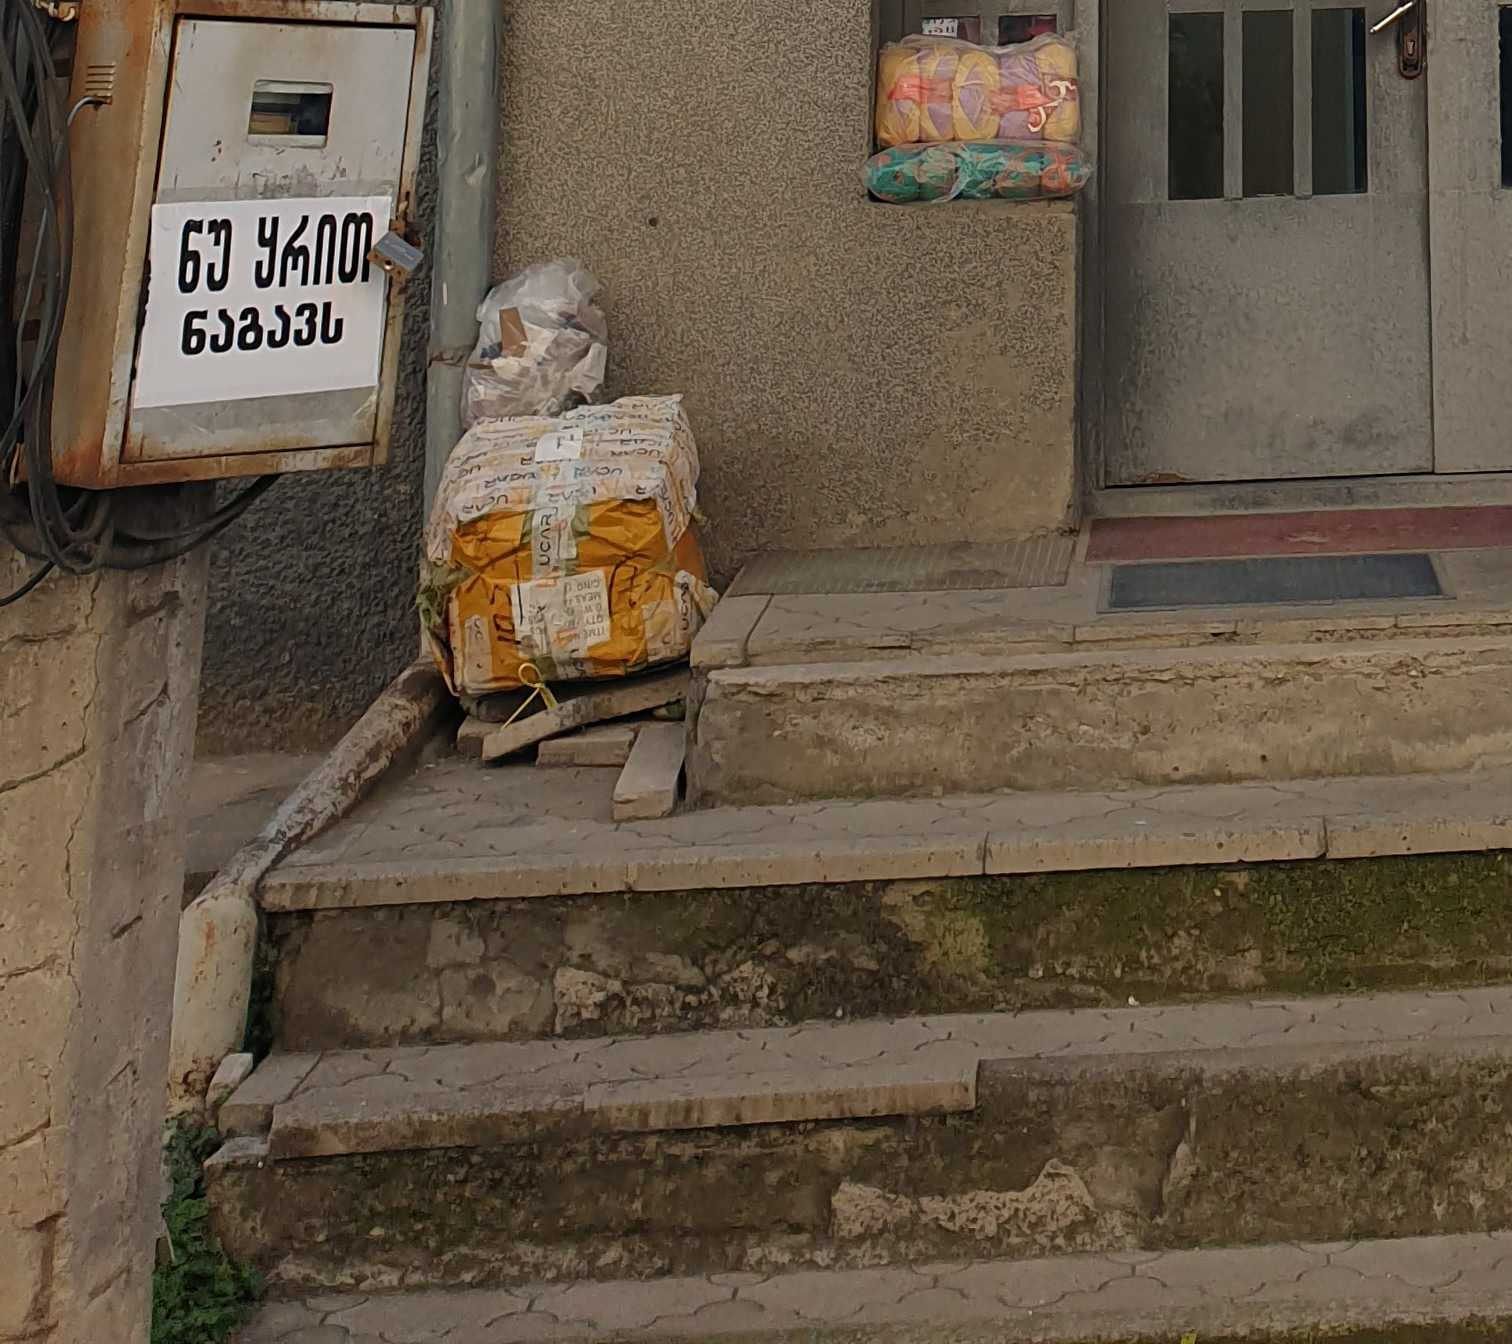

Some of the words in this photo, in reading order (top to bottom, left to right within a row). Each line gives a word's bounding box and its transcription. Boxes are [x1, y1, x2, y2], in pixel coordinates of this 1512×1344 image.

[177, 216, 233, 295] ნუ
[253, 212, 374, 289] ყრით
[180, 301, 344, 356] ნაგავს
[538, 513, 553, 566] UCAR
